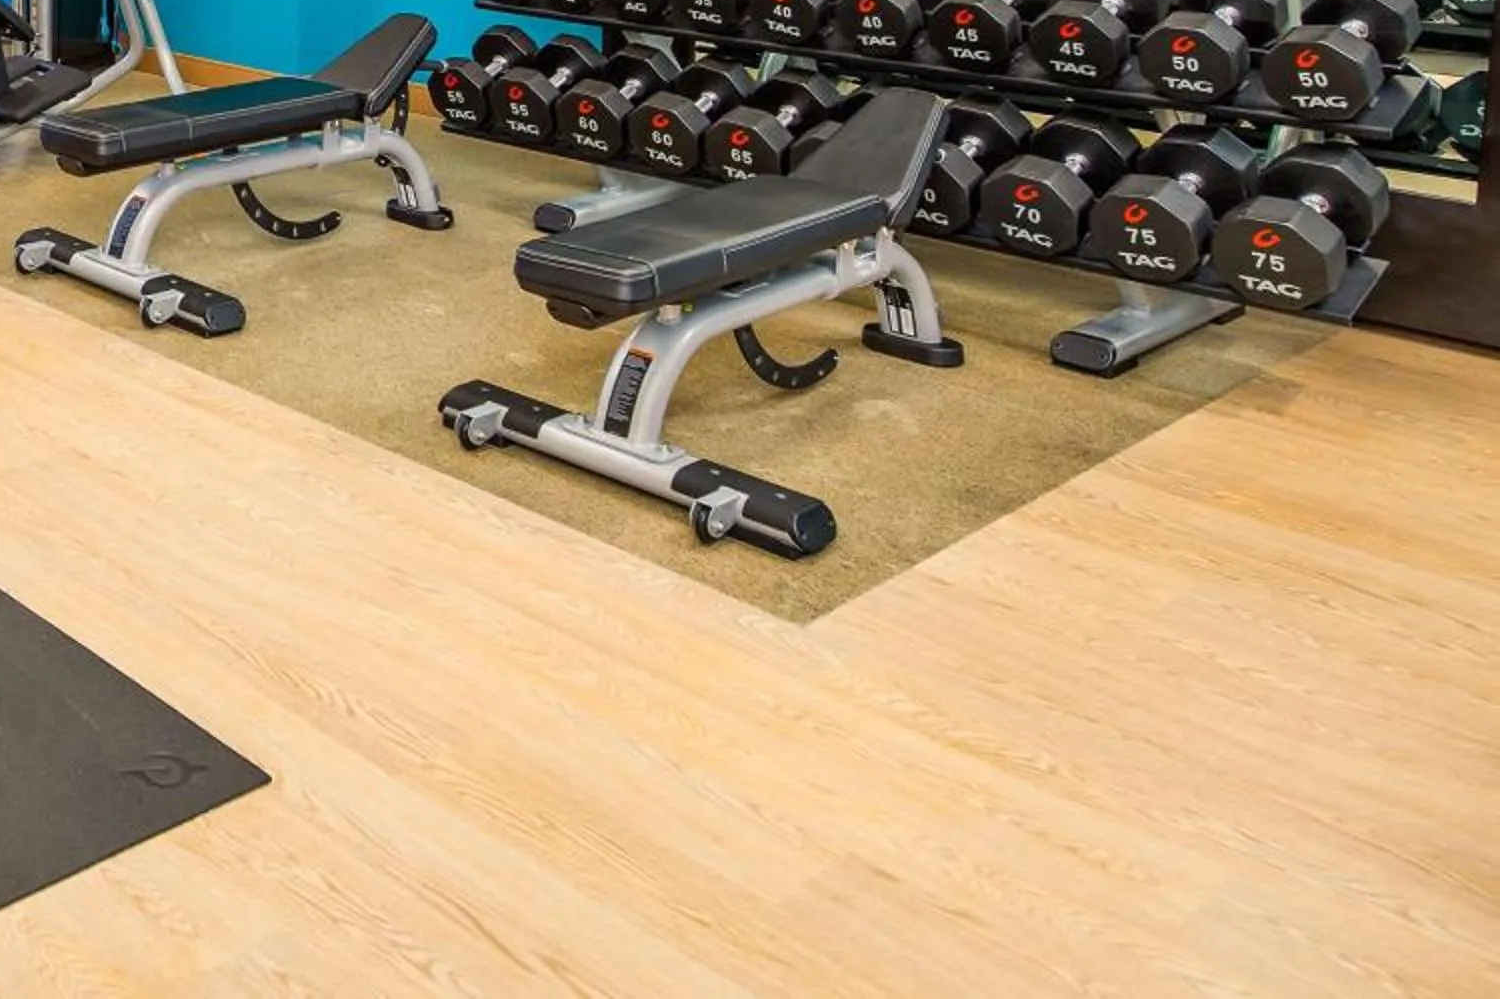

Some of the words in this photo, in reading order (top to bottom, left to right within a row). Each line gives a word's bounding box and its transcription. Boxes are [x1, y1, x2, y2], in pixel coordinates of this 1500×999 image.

[687, 9, 723, 25] TAG
[772, 4, 792, 19] 40
[764, 18, 801, 38] TAG
[862, 16, 883, 29] 40
[857, 34, 897, 47] TAG
[955, 28, 979, 42] 45
[947, 46, 991, 62] TAG
[1059, 40, 1085, 57] 45
[1049, 59, 1097, 77] TAG
[1171, 55, 1199, 72] 50
[1161, 76, 1214, 94] TAG
[1297, 72, 1329, 88] 50
[509, 102, 529, 117] 55
[1291, 95, 1349, 109] TAG
[445, 108, 477, 121] TAG
[505, 119, 541, 136] TAG
[578, 116, 599, 132] 60
[572, 132, 609, 152] TAG
[651, 130, 673, 147] 60
[645, 146, 684, 167] TAG
[730, 148, 753, 165] 65
[915, 208, 949, 226] AG
[1013, 203, 1041, 224] 70
[1001, 222, 1053, 248] TAG
[1124, 226, 1157, 246] 75
[1118, 251, 1176, 271] TAG
[1251, 251, 1285, 273] 75
[1238, 274, 1303, 300] TAG
